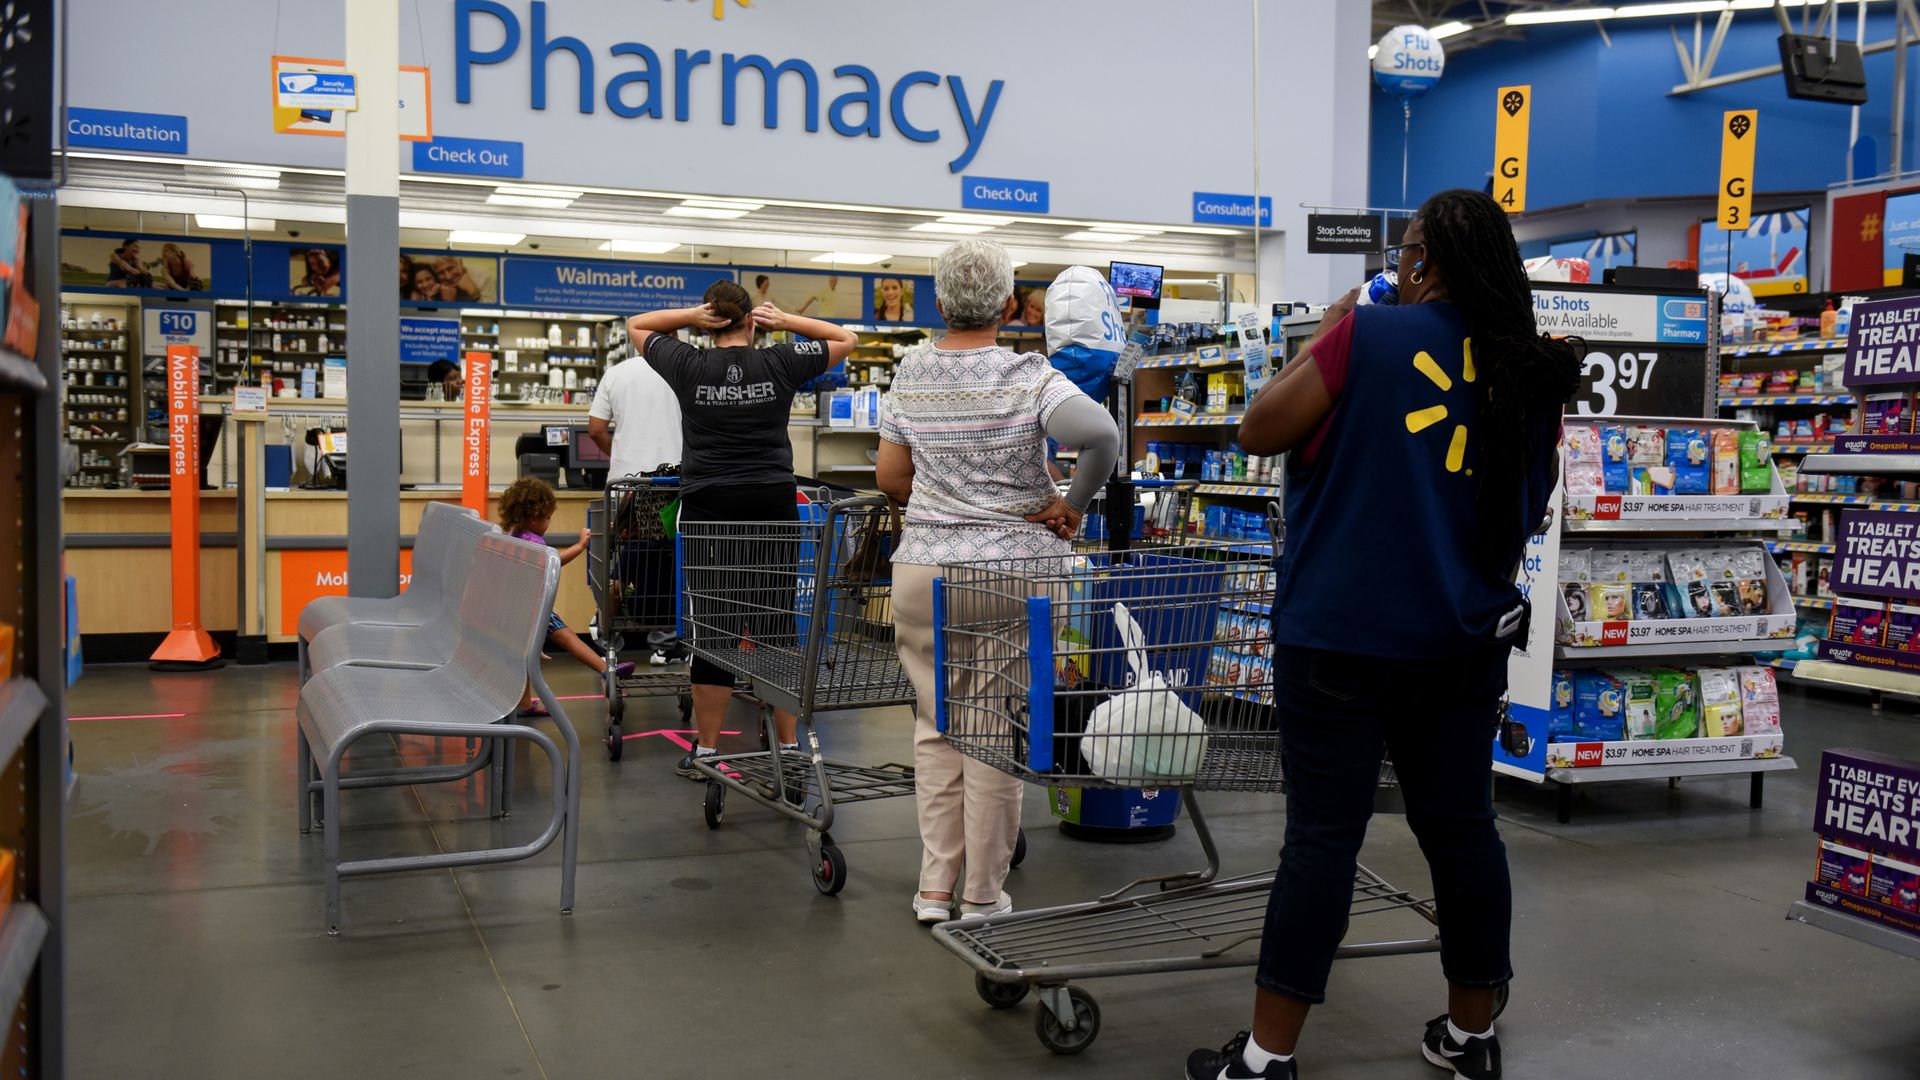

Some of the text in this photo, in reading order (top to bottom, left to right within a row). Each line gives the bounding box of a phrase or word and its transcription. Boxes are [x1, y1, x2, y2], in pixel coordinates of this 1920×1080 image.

[1404, 34, 1430, 51] Flu
[1394, 53, 1440, 71] Shots
[454, 0, 1006, 174] Pharmacy
[67, 119, 181, 142] Consultation
[428, 146, 509, 166] Check Out
[1500, 157, 1519, 179] G
[973, 185, 1038, 203] Check Out
[1726, 177, 1745, 198] G
[1501, 187, 1515, 207] 4
[1727, 206, 1740, 225] 3
[1316, 226, 1371, 238] Stop Smoking
[556, 266, 685, 290] Walmart.com
[1552, 296, 1590, 311] Shots
[163, 313, 193, 330] $10
[1561, 312, 1618, 329] Available
[1860, 313, 1865, 327] 1
[401, 325, 458, 336] We accept most
[1663, 328, 1701, 340] Pharmacy
[696, 381, 776, 401] FINISHER
[170, 354, 188, 475] Mobile Express
[466, 361, 486, 476] Mobile Express
[1845, 440, 1867, 450] equate
[1870, 442, 1908, 451] Omeprazole
[1596, 502, 1744, 512] NEW $3.97 HOME SPA HAIR TREATMENT
[1848, 521, 1855, 535] 1
[1857, 521, 1914, 538] TABLET
[1603, 623, 1752, 639] NEW $3.97 HOME SPA HAIR TREATMENT
[1829, 648, 1852, 657] equate
[1855, 653, 1896, 666] Omeprazole
[1577, 744, 1736, 760] NEW $3.97 HOME SPA HAIR TREATMENT
[1830, 763, 1920, 796] 1 TABLET EV
[1828, 778, 1905, 813] TREATS
[1815, 889, 1839, 903] equate
[1841, 899, 1882, 918] Omeprazole
